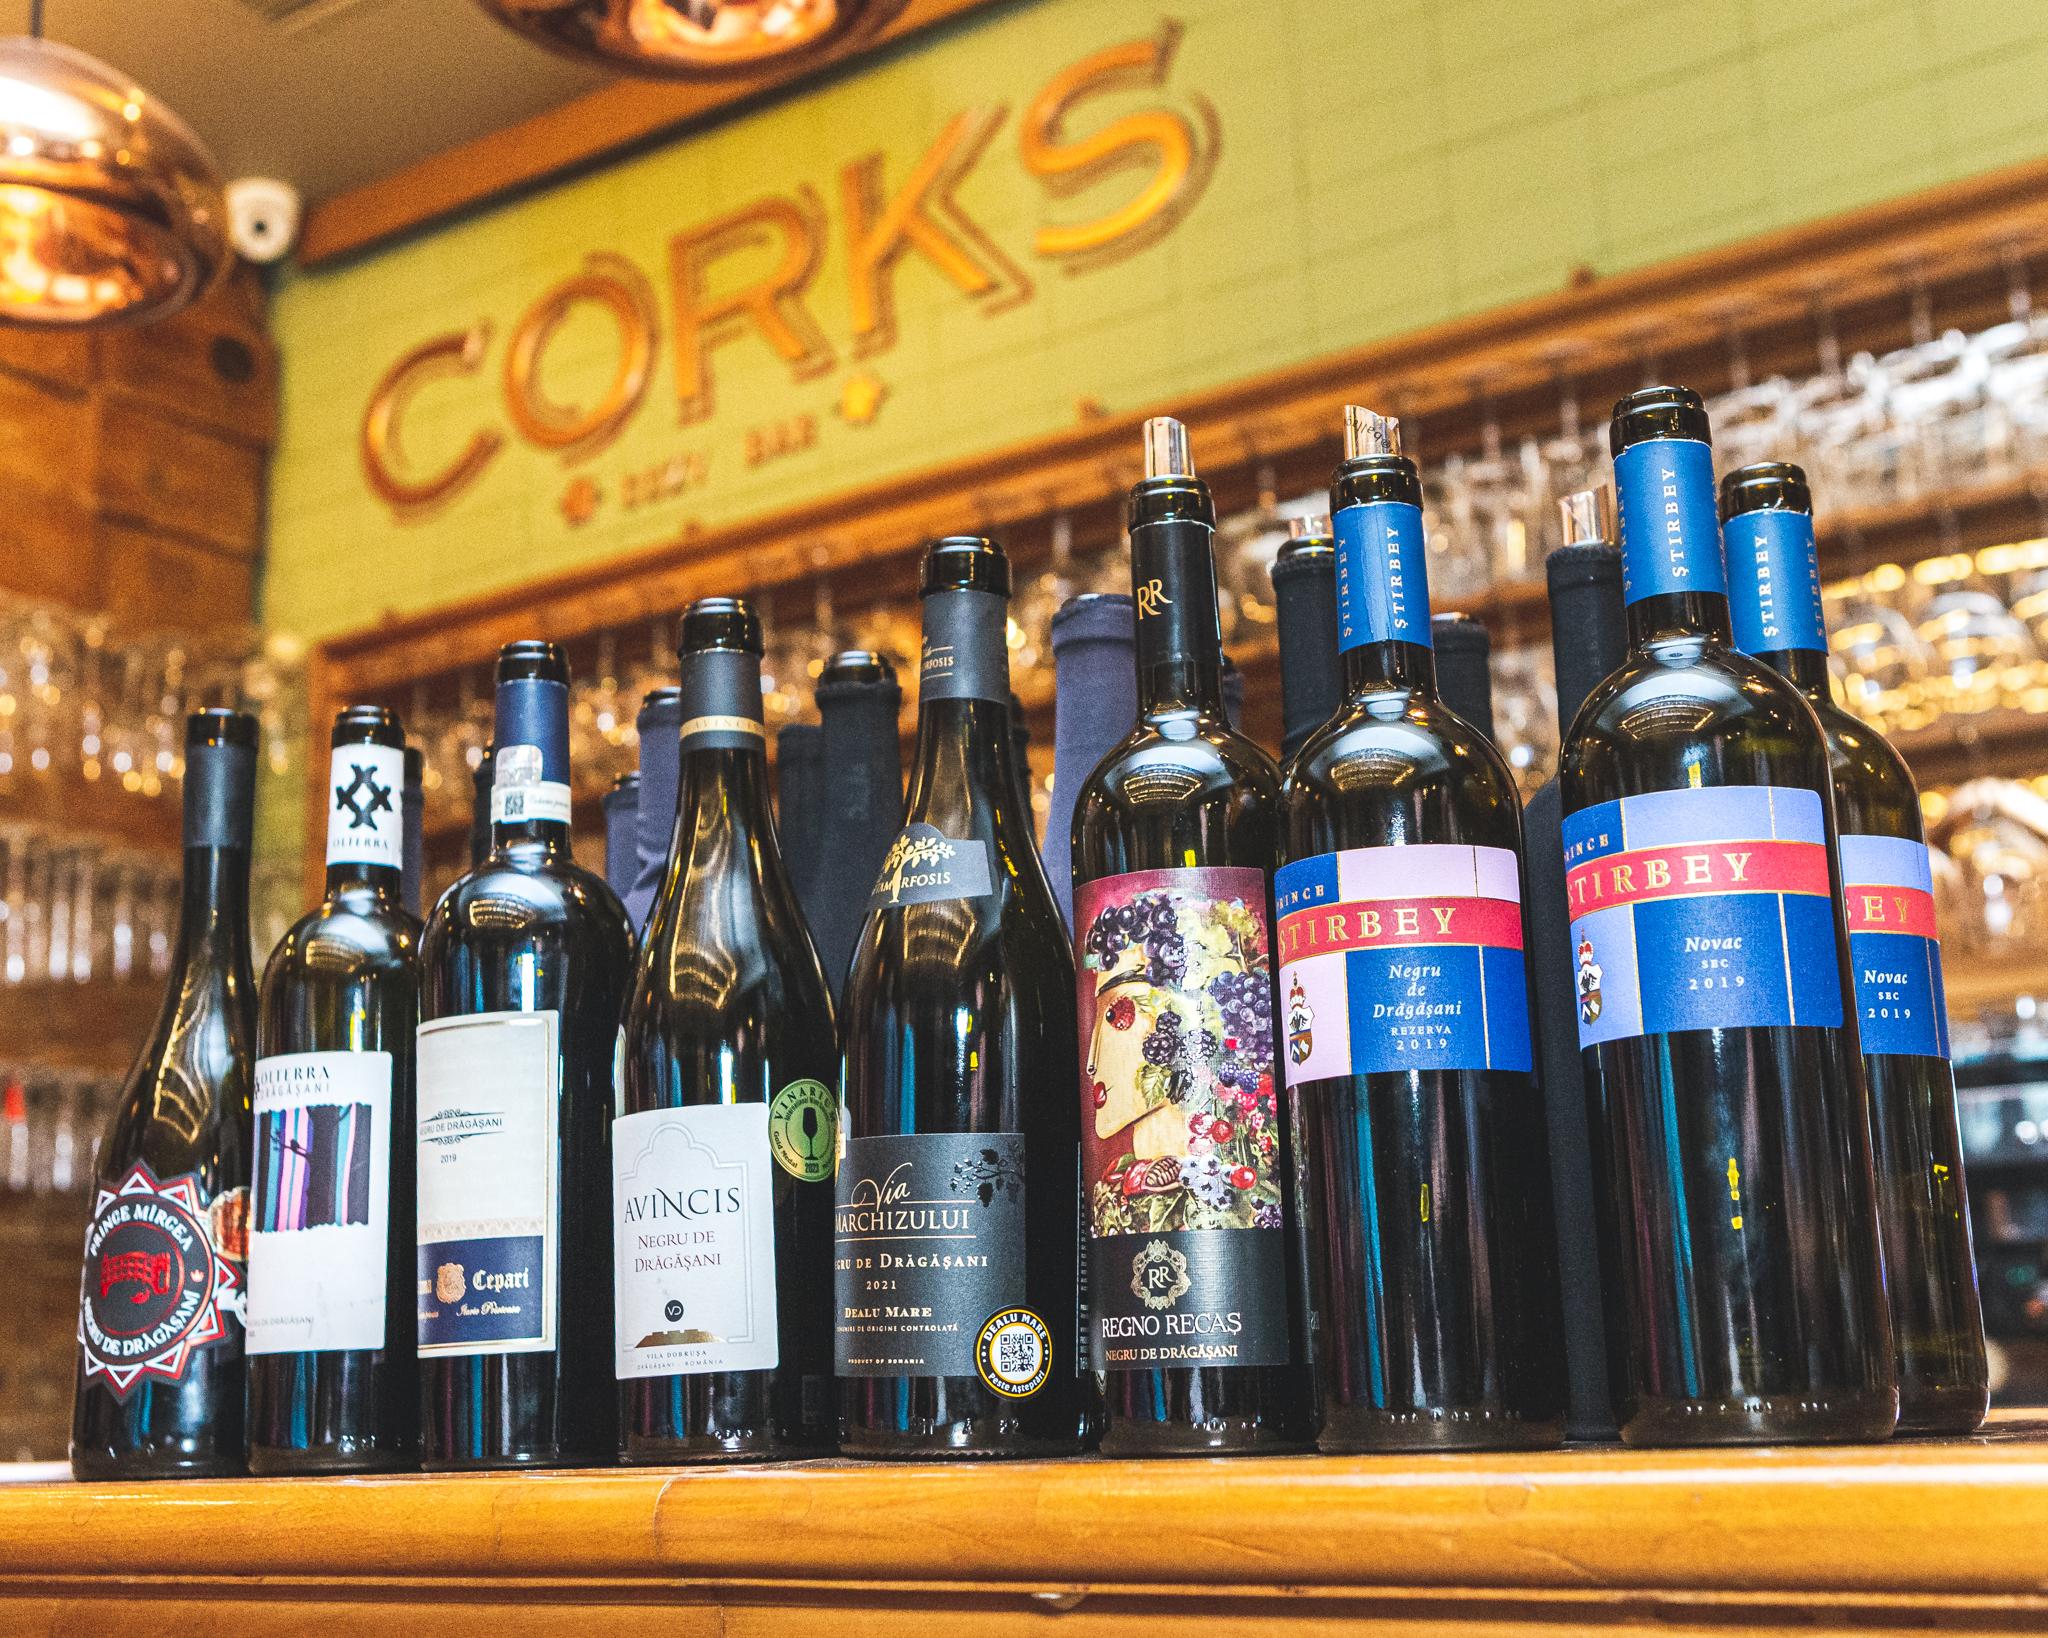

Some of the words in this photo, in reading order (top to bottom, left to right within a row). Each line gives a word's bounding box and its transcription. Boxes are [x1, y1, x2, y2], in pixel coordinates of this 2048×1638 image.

[360, 18, 1222, 520] CORKS
[1684, 935, 1743, 953] Novac
[1701, 958, 1729, 970] SEC
[1389, 964, 1441, 983] Negru
[1864, 969, 1908, 985] Novac
[1407, 982, 1426, 997] de
[1688, 975, 1745, 991] 2019
[1878, 991, 1900, 1000] SEC
[1868, 1007, 1911, 1019] 2019
[1391, 1025, 1452, 1036] REZERVA
[1396, 1038, 1448, 1050] 2019
[441, 1153, 457, 1163] 2019
[851, 1162, 913, 1212] Via
[624, 1187, 740, 1223] AVINCIS
[638, 1232, 688, 1250] NEGRU
[693, 1230, 716, 1244] DE
[856, 1258, 872, 1269] DE
[866, 1280, 896, 1290] 2021
[1148, 1266, 1174, 1289] RR
[845, 1307, 880, 1319] DEALU
[885, 1306, 932, 1318] MARE
[983, 1313, 1018, 1341] DEALU
[1021, 1313, 1047, 1340] MARE
[1102, 1315, 1160, 1338] REGNO
[1105, 1348, 1138, 1361] NEGRU
[1140, 1348, 1157, 1360] DE
[988, 1372, 1011, 1391] Peste
